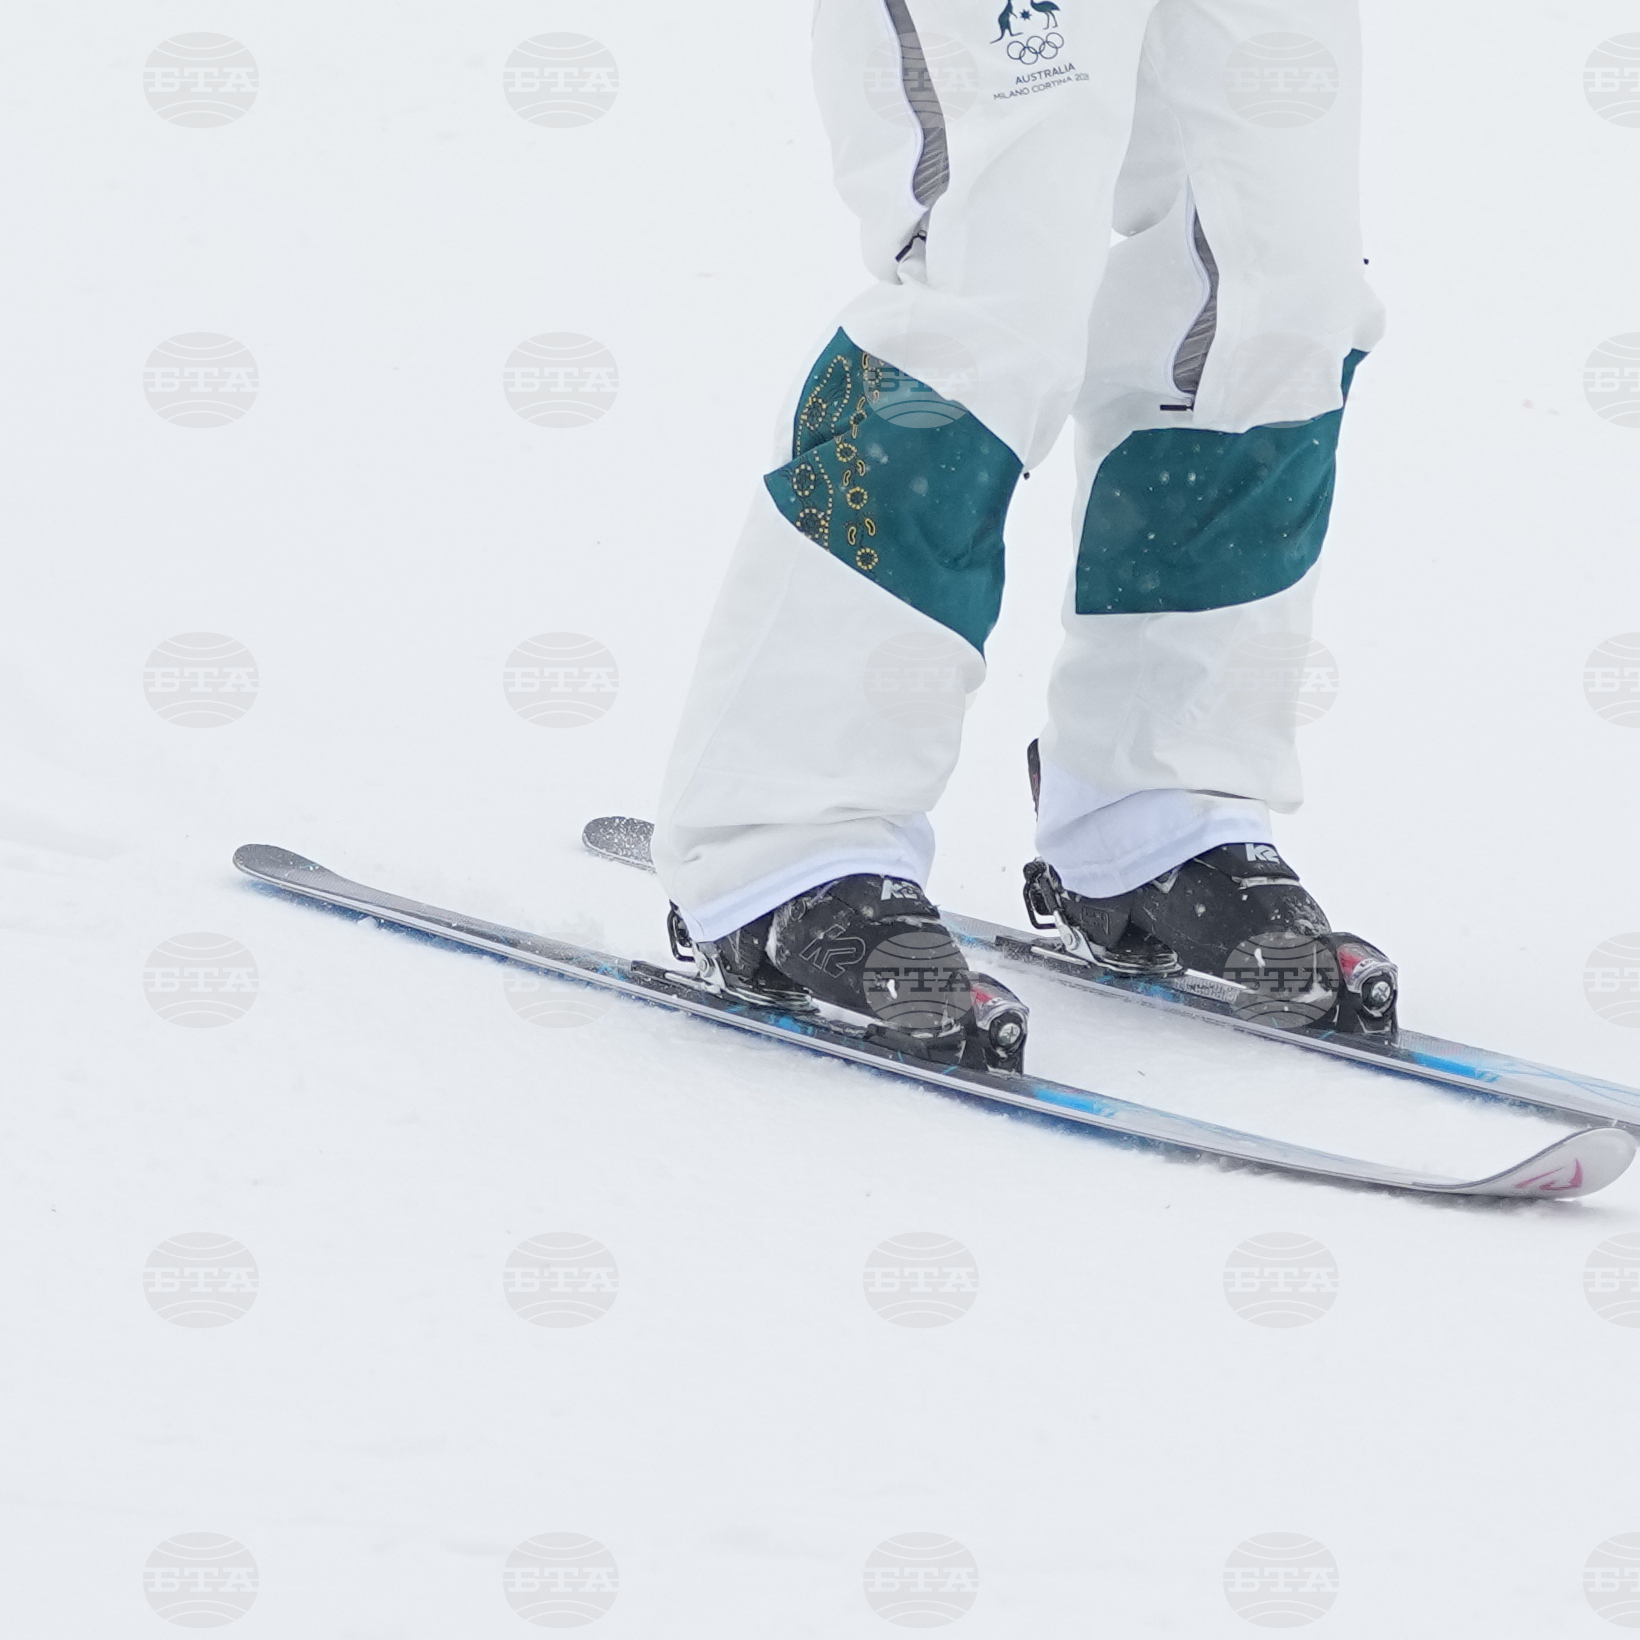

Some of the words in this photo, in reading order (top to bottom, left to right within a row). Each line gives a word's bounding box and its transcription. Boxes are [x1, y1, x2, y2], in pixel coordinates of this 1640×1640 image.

[1015, 62, 1076, 86] AUSTRALIA
[1245, 843, 1281, 864] K2
[880, 879, 919, 901] K2
[799, 923, 867, 979] K2
